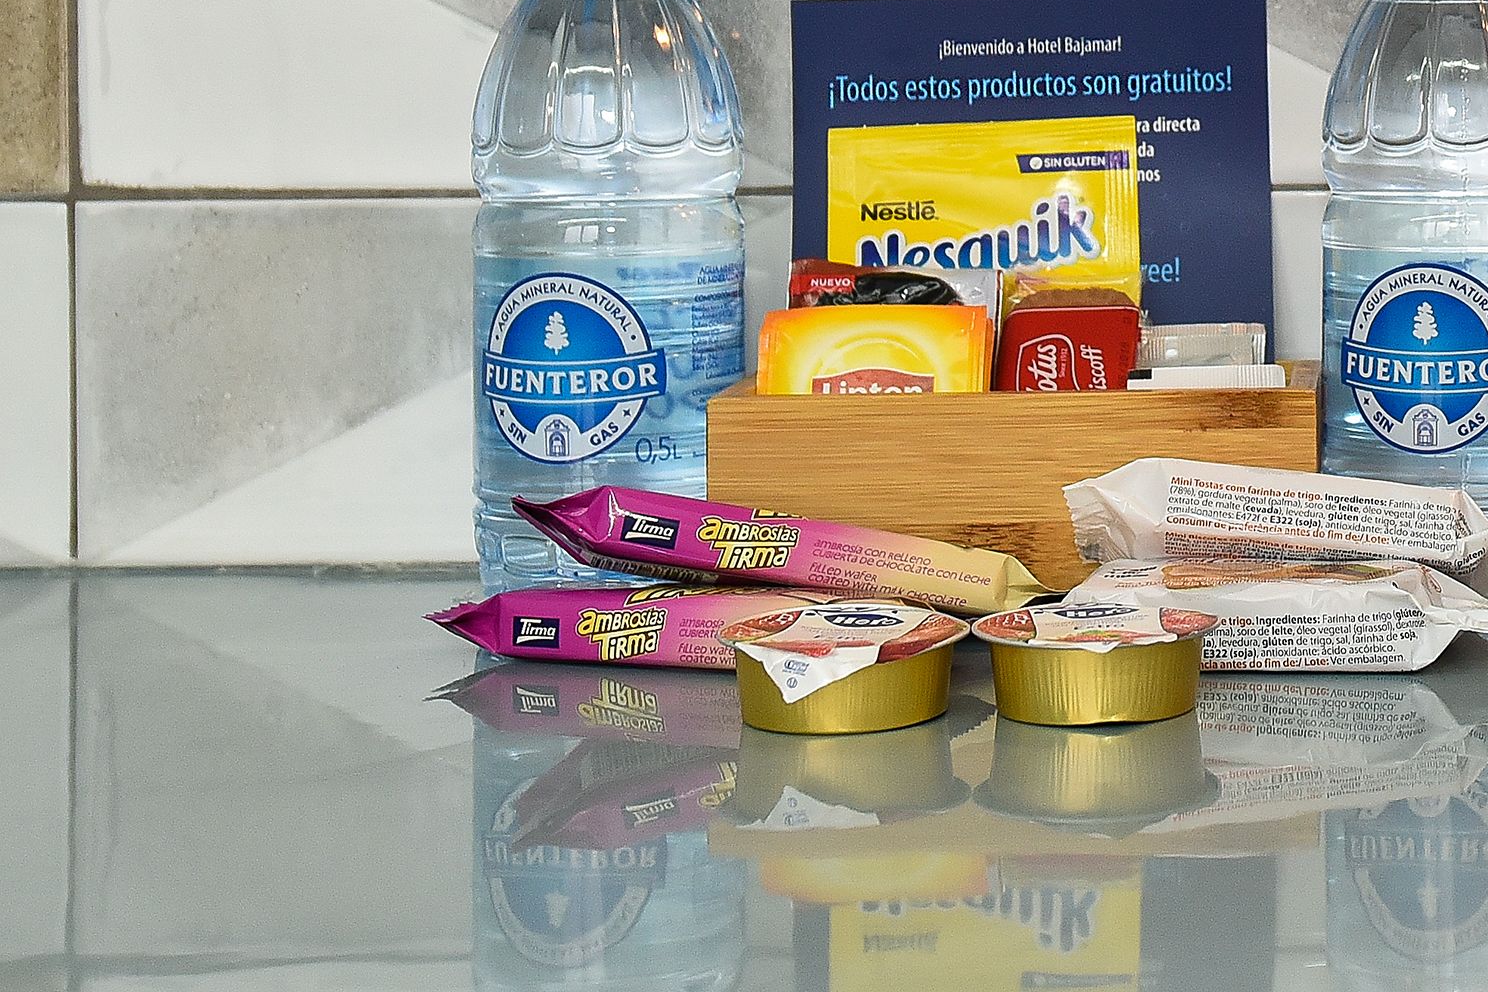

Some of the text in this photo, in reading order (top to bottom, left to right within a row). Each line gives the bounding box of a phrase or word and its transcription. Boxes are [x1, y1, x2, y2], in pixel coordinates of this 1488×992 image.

[938, 36, 1122, 60] ¡Bienvenido a Hotel Bajamar!
[829, 65, 1232, 109] ¡Todos estos productos son gratuitos!
[1152, 116, 1200, 133] directa
[1043, 155, 1106, 168] SIN GLUTEN
[860, 199, 936, 221] Nestlé
[860, 194, 1094, 270] Nesquik
[810, 277, 851, 288] NUEVO
[498, 282, 630, 332] AGUA MINERAL NATURAL
[1362, 290, 1388, 322] AGUA
[1388, 273, 1444, 293] MINERAL
[485, 364, 658, 395] FUENTEROR
[1026, 344, 1058, 392] otus
[1080, 344, 1107, 391] iscoff
[507, 421, 620, 446] SIN GAS
[1373, 411, 1486, 437] SIN GAS
[1170, 476, 1421, 510] Mini Tostas com farinha de trigo. Ingredientes: Farinha
[1198, 489, 1233, 501] gordura
[1234, 493, 1267, 506] vegetal
[1268, 496, 1303, 509] (palma),
[1338, 502, 1361, 513] leite,
[1362, 504, 1382, 514] óleo
[1383, 508, 1416, 520] vegetal
[1168, 495, 1444, 531] extrato de malte (cevada), levedura, glúten trigo, sal, farinha
[632, 516, 674, 537] Tirma
[1166, 515, 1214, 529] Consumir
[1284, 528, 1311, 538] antes
[1312, 529, 1325, 539] do
[1327, 530, 1343, 539] fim
[1365, 534, 1390, 544] Lote:
[1391, 536, 1405, 545] Ver
[1269, 515, 1293, 525] E322
[1295, 517, 1324, 529] (soja),
[1325, 521, 1383, 534] antioxidante:
[1384, 525, 1409, 536] ácido
[1409, 529, 1454, 541] ascórbico.
[520, 618, 556, 637] Tirma
[1228, 611, 1392, 627] trigo. Ingredientes: Farinha de trigo
[1237, 628, 1256, 636] soro
[1272, 626, 1295, 636] leite,
[1296, 625, 1316, 634] óleo
[1318, 624, 1352, 636] vegetal
[1203, 643, 1396, 660] E322 (soja), antioxidante: ácido ascórbico.
[1219, 638, 1260, 648] levedura,
[1262, 637, 1294, 648] glúten
[1310, 636, 1334, 647] trigo,
[1335, 633, 1351, 644] sal,
[1352, 633, 1384, 644] farinha
[1220, 660, 1247, 669] antes
[1248, 658, 1263, 669] do
[1264, 657, 1280, 668] fim
[1304, 656, 1329, 667] Lote:
[1330, 655, 1349, 665] Ver
[1351, 653, 1406, 665] embalagem.
